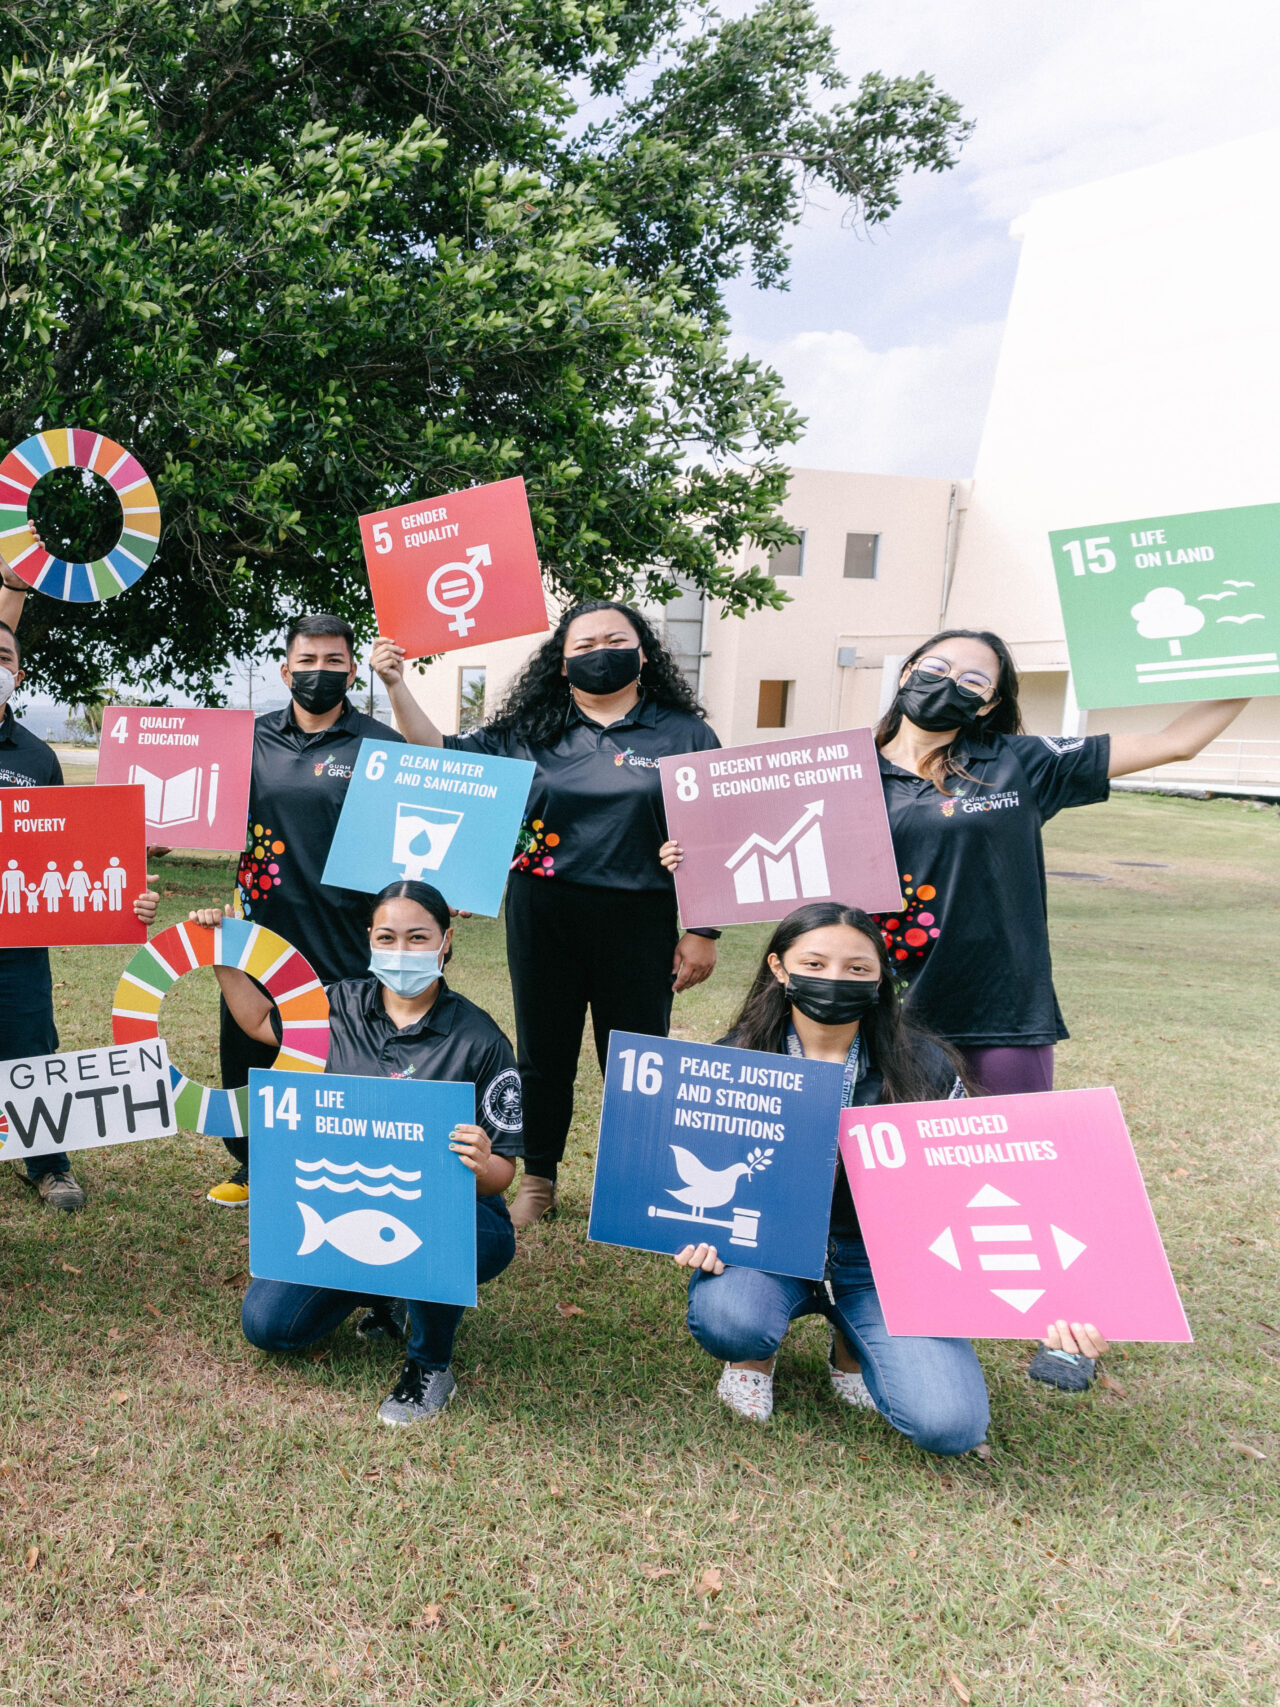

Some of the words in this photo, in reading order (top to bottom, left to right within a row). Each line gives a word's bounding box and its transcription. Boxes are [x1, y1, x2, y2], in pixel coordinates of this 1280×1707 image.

[401, 507, 447, 529] GENDER
[372, 521, 392, 554] 5
[405, 523, 458, 548] EQUALITY
[1130, 529, 1167, 547] LIFE
[1062, 536, 1116, 576] 15
[1135, 552, 1161, 568] ON
[1166, 546, 1214, 565] LAND
[111, 716, 128, 744] 4
[140, 717, 185, 729] QUALITY
[138, 733, 199, 746] EDUCATION
[365, 750, 388, 780] 6
[400, 755, 439, 771] CLEAN
[442, 760, 484, 778] WATER
[709, 756, 762, 777] DECENT
[766, 749, 813, 768] WORK
[816, 744, 848, 762] AND
[394, 772, 421, 786] AND
[424, 776, 497, 798] SANITATION
[675, 766, 699, 801] 8
[712, 774, 790, 797] ECONOMIC
[794, 764, 862, 786] GROWTH
[14, 800, 29, 813] NO
[963, 797, 1019, 813] GROWTH
[990, 791, 1018, 799] GREEN
[14, 818, 66, 832] POVERTY
[10, 1046, 162, 1089] GREEN
[619, 1049, 663, 1095] 16
[680, 1057, 734, 1083] PEACE,
[738, 1066, 803, 1091] JUSTICE
[258, 1086, 301, 1130] 14
[316, 1090, 344, 1108] LIFE
[677, 1083, 711, 1103] AND
[716, 1089, 781, 1114] STRONG
[316, 1116, 367, 1137] BELOW
[371, 1120, 424, 1141] WATER
[675, 1108, 784, 1141] INSTITUTIONS
[917, 1115, 1008, 1138] REDUCED
[848, 1122, 906, 1169] 10
[924, 1141, 1058, 1167] INEQUALITIES
